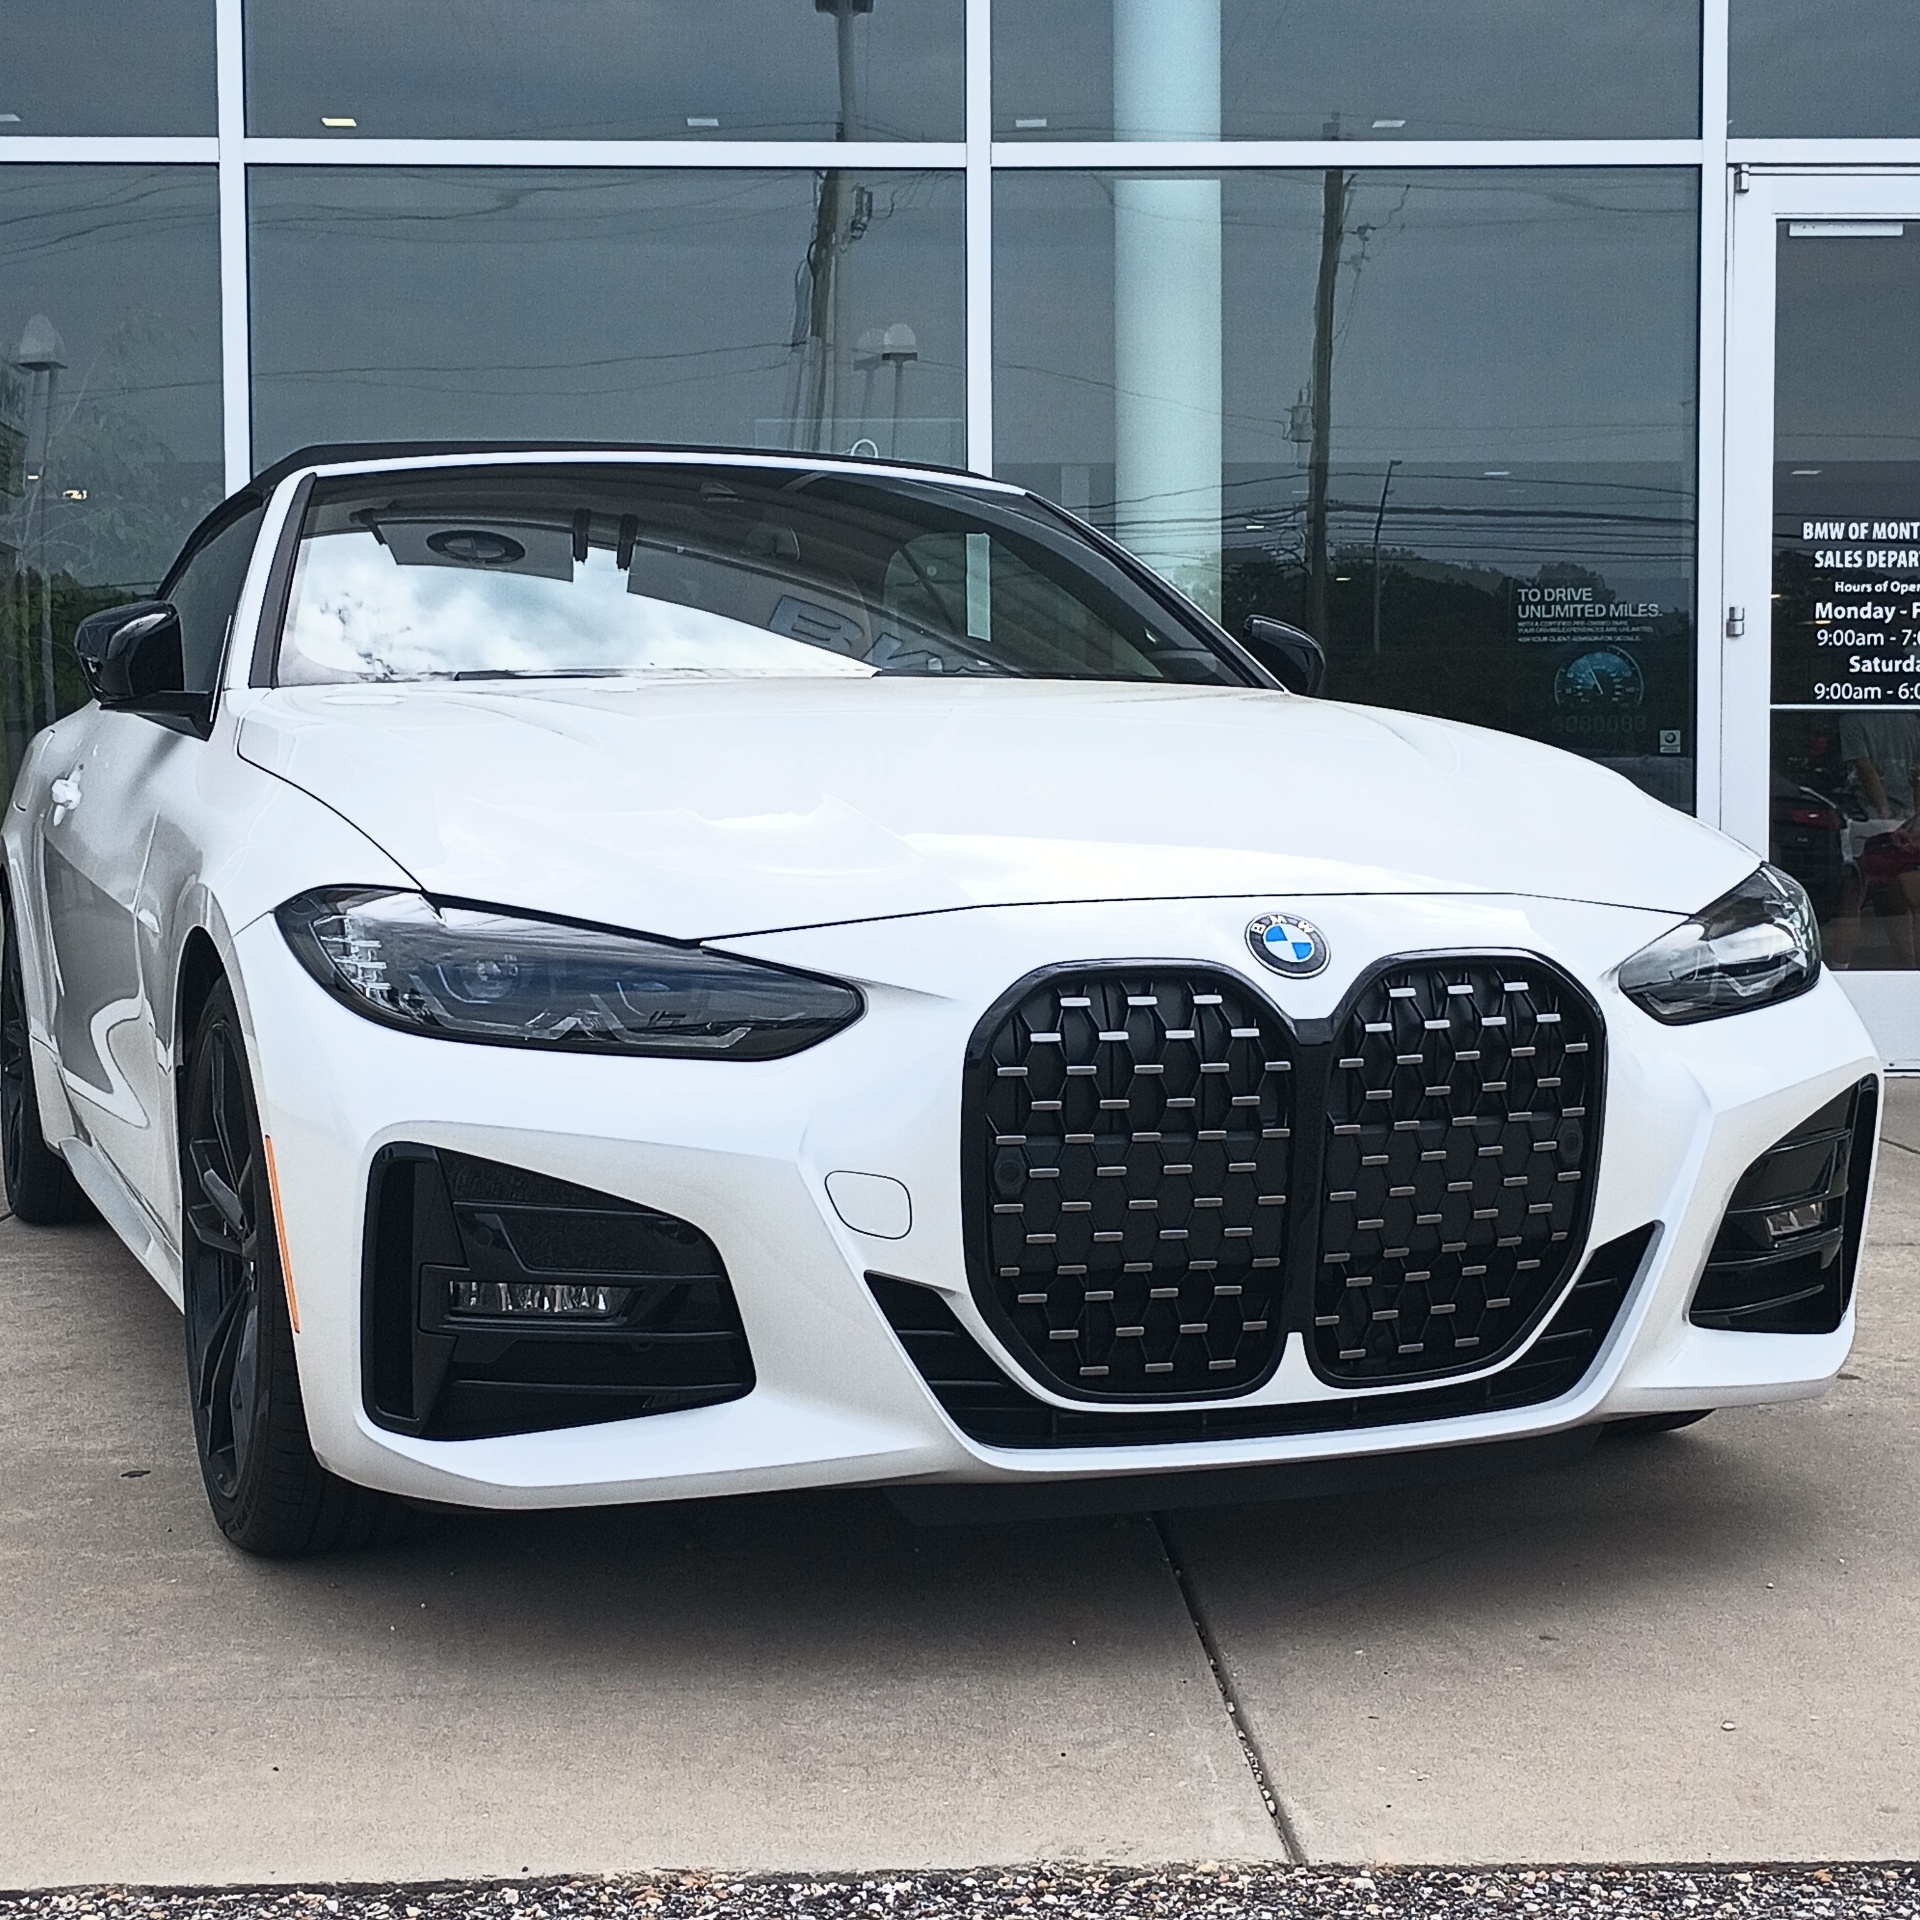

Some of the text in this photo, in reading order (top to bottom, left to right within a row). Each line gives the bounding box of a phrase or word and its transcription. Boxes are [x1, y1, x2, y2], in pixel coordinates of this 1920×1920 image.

[1803, 522, 1920, 540] BMW OF MONT
[1814, 550, 1920, 568] SALES DEPAR
[1517, 587, 1593, 602] TO DRIVE
[1835, 581, 1873, 593] Hours
[1874, 580, 1889, 593] of
[1517, 603, 1663, 618] UNLIMITED MILES.
[1815, 601, 1896, 624] Monday
[1816, 628, 1885, 646] 9:00am
[1814, 682, 1882, 700] 9:00am
[1251, 915, 1314, 934] BMW
